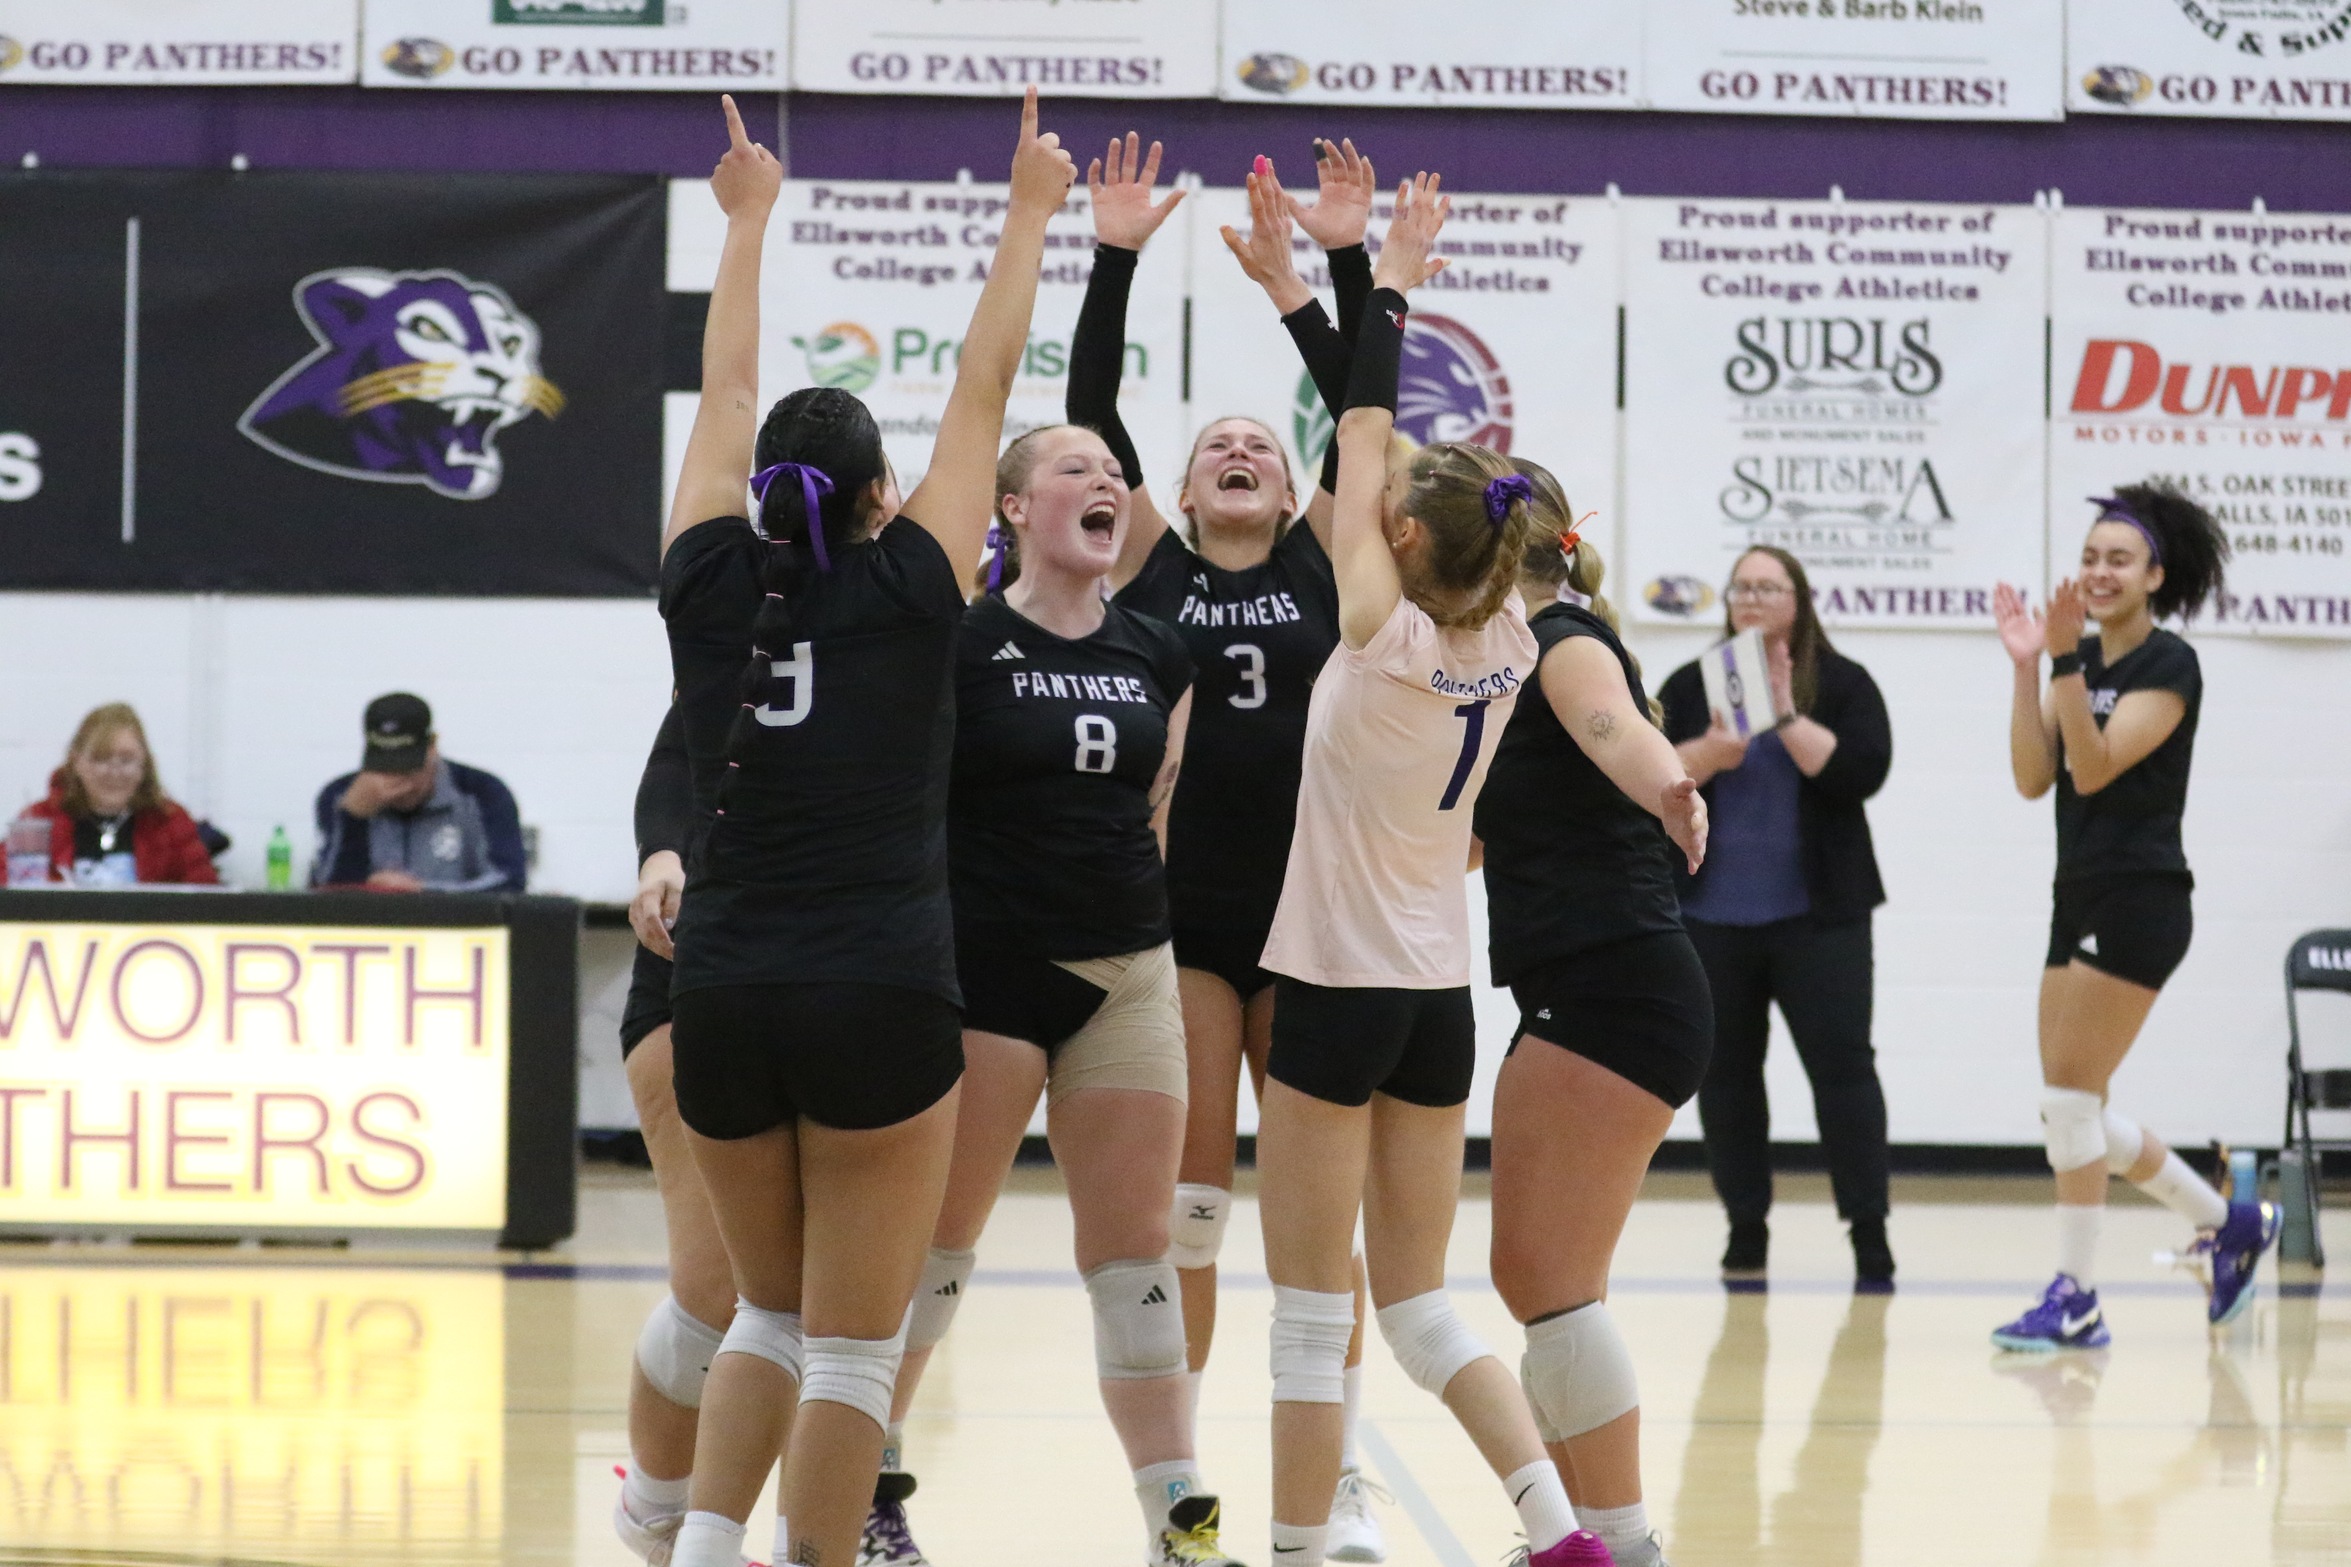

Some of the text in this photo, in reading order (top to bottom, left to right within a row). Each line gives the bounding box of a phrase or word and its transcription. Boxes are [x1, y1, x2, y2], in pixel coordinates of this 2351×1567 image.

[1914, 0, 1983, 22] Klein
[30, 41, 343, 73] GO PANTHERS!
[462, 46, 776, 79] GO PANTHERS!
[849, 51, 1164, 86] GO PANTHERS!
[1317, 63, 1628, 96] GO PANTHERS!
[1700, 70, 2007, 106] GO PANTHERS!
[2159, 74, 2218, 104] GO
[811, 186, 912, 212] Proud
[1534, 203, 1568, 225] of
[791, 221, 949, 247] Ellsworth
[1679, 205, 1995, 236] Proud supporter of
[2104, 214, 2200, 240] Proud
[833, 255, 956, 285] College
[1659, 239, 2012, 272] Ellsworth Community
[2085, 248, 2239, 276] Ellsworth
[1701, 273, 1980, 303] College Athletics
[2127, 284, 2247, 313] College
[892, 326, 1149, 379] Prisn
[1724, 314, 1943, 397] SURLS
[2074, 426, 2208, 445] MOTORS
[2240, 429, 2325, 448] IOWA
[1719, 455, 1957, 523] SIETSEMA
[2223, 474, 2275, 496] OAK
[2216, 505, 2278, 526] ALLS,
[2235, 533, 2344, 556] 648-4140
[1178, 591, 1301, 628] PANTHERS
[1011, 671, 1148, 704] PANTHERS
[1222, 643, 1268, 710] 3
[1073, 714, 1118, 775] 8
[1437, 699, 1491, 811] 1
